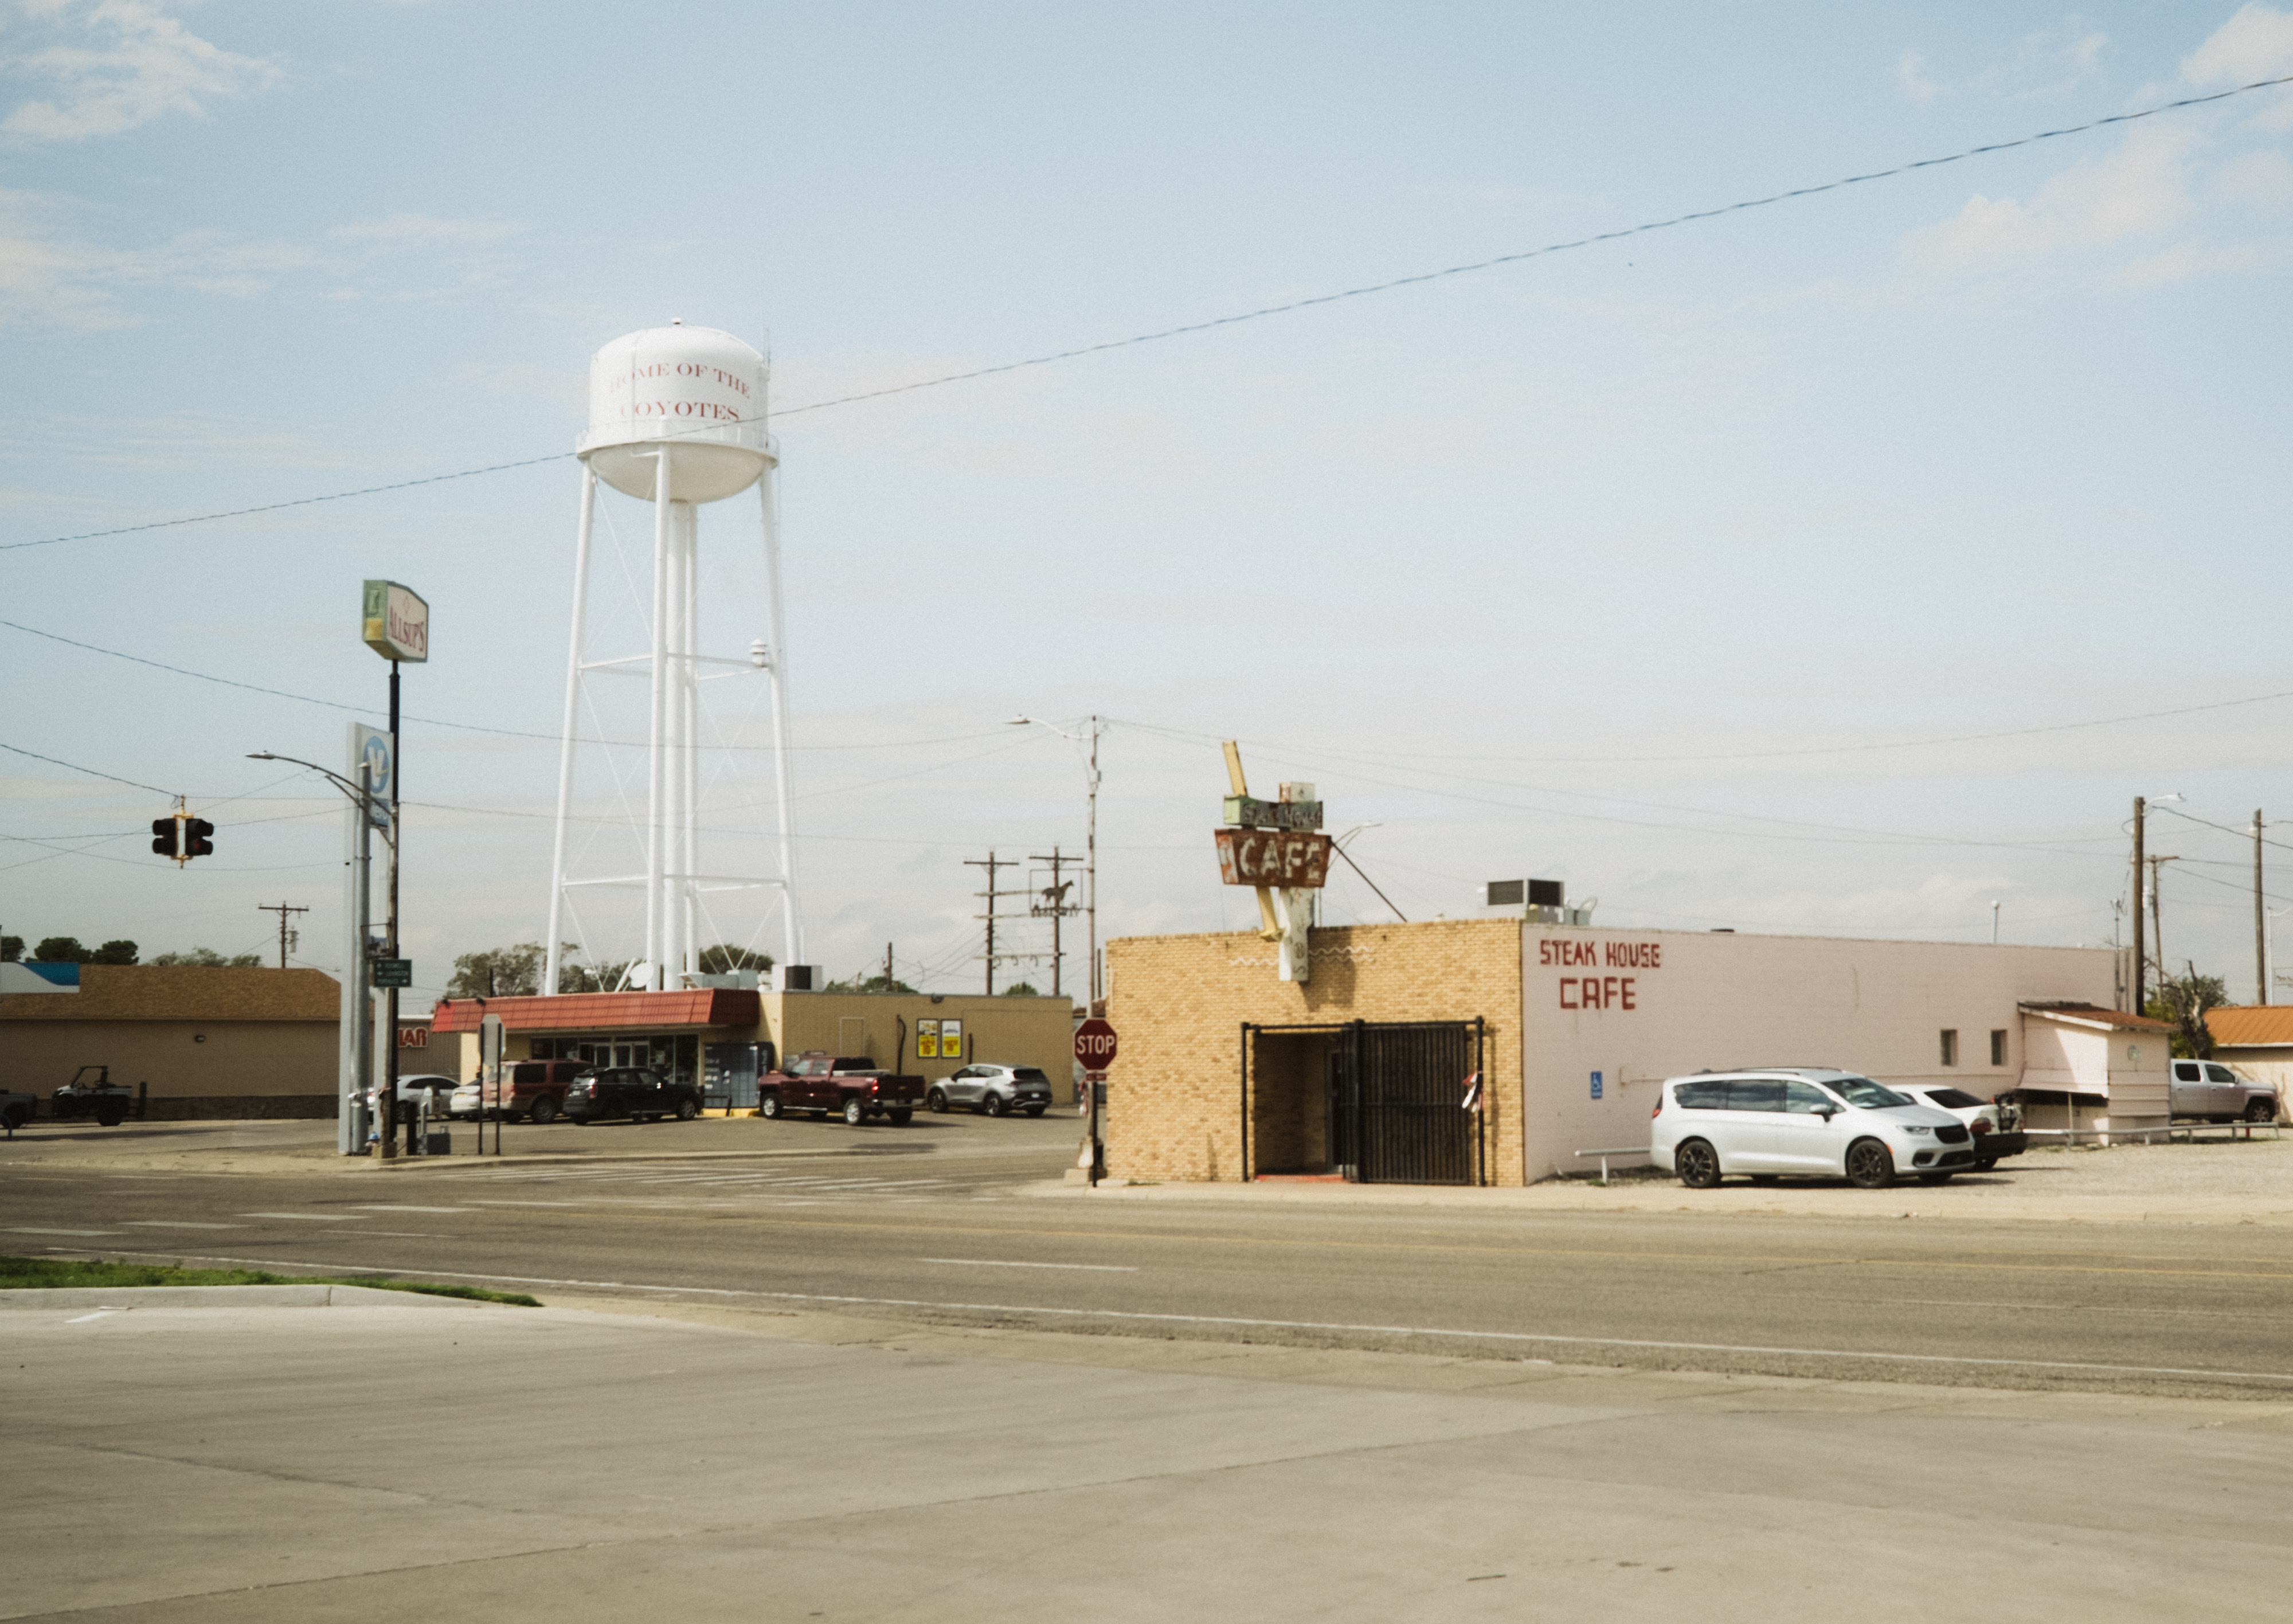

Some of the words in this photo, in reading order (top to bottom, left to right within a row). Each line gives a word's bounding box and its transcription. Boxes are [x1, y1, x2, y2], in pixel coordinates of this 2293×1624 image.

[676, 362, 707, 377] OF
[713, 367, 750, 399] THE
[1239, 837, 1320, 879] CAFE
[1540, 939, 1597, 966] STEAK
[1606, 941, 1661, 968] HOUSE
[1559, 976, 1636, 1010] CAFE
[1077, 1035, 1116, 1054] STOP
